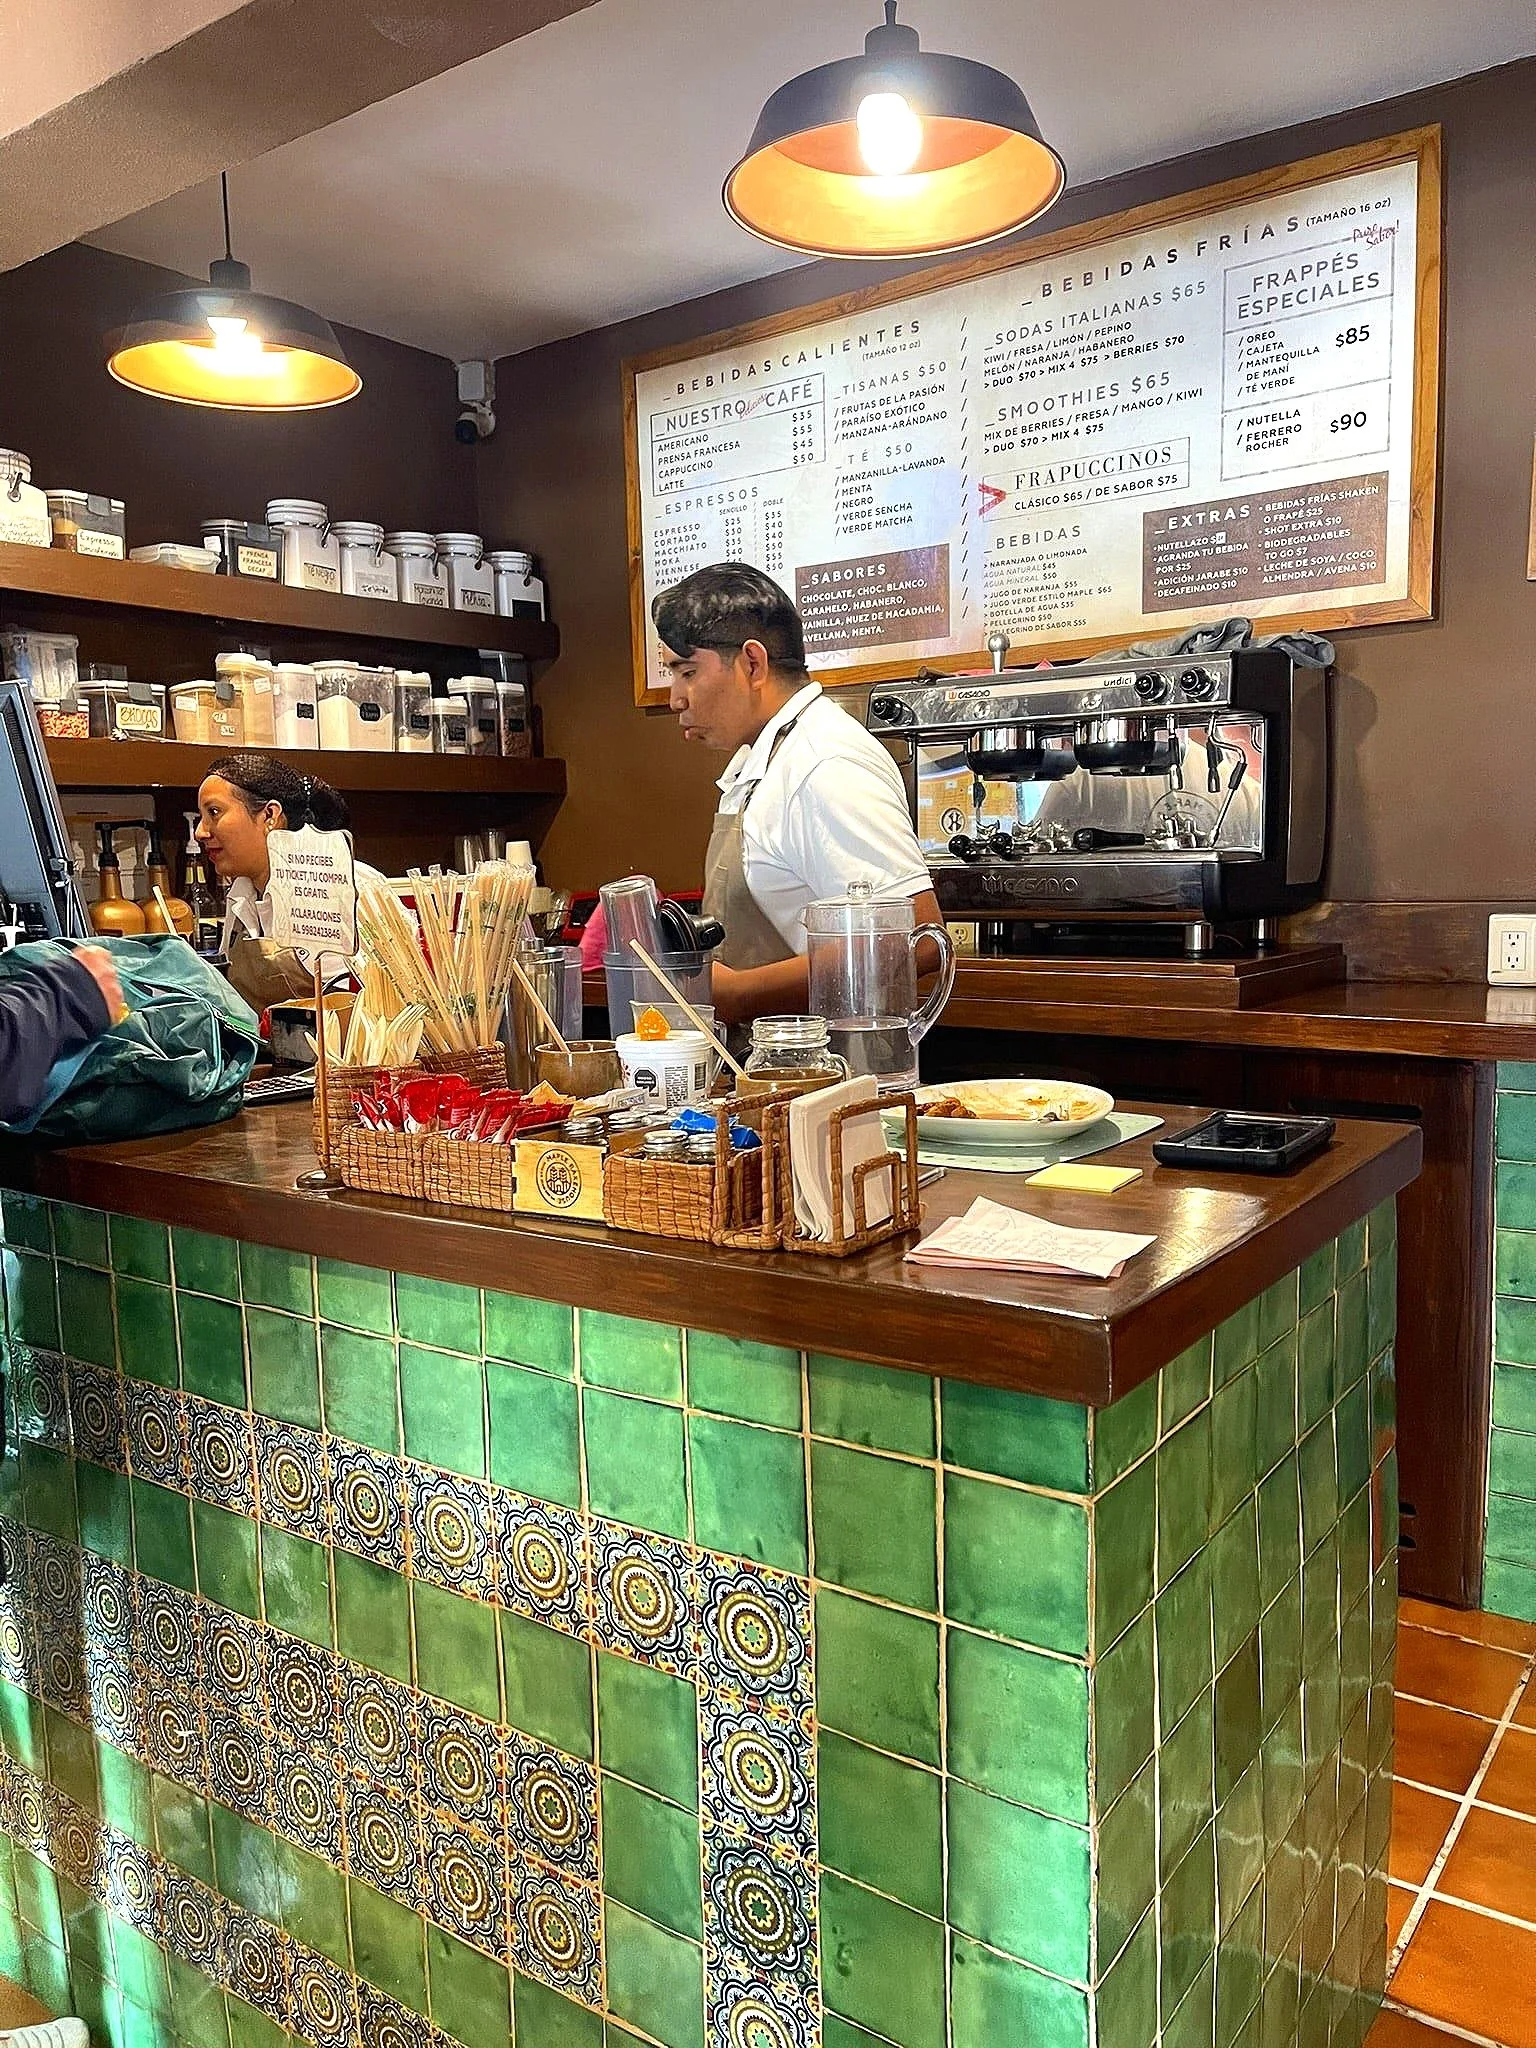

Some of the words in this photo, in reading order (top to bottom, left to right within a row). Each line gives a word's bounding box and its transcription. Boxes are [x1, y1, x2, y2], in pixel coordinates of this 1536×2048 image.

[1197, 216, 1298, 256] FRÍAS
[1360, 203, 1370, 212] 16
[1062, 292, 1161, 328] ITALIANAS
[1172, 280, 1205, 302] $65
[1238, 272, 1379, 319] ESPECIALES
[781, 320, 919, 367] CALIENTES
[984, 353, 1004, 364] KIWI
[1014, 343, 1043, 357] FRESA
[1053, 333, 1083, 347] LIMÓN
[1095, 321, 1131, 337] PEPINO
[1246, 330, 1275, 343] OREO
[1335, 324, 1369, 347] $85
[984, 363, 1015, 377] MELÓN
[1024, 350, 1070, 367] NARANJA
[1078, 334, 1134, 354] HABANERO
[1246, 346, 1319, 368] MANTEQUILLA
[1247, 341, 1284, 355] CAJETA
[918, 361, 946, 377] $50
[992, 375, 1013, 387] DUO
[1019, 370, 1036, 381] $70
[1048, 363, 1065, 374] MIX
[1080, 355, 1098, 367] $75
[1113, 340, 1158, 359] BERRIES
[1165, 335, 1184, 347] $70
[1246, 371, 1259, 381] DE
[1263, 363, 1288, 377] MANÍ
[1132, 371, 1169, 394] $65
[1245, 383, 1257, 393] TÉ
[1261, 376, 1294, 390] VERDE
[764, 378, 812, 407] CAFÉ
[841, 399, 876, 415] FRUTAS
[879, 396, 891, 406] DE
[894, 393, 906, 403] LA
[909, 384, 944, 399] PASIÓN
[842, 412, 881, 428] PARAÍSO
[884, 402, 925, 418] EXÓTICO
[984, 430, 1002, 441] MIX
[1005, 427, 1017, 437] DE
[1021, 417, 1064, 434] BERRIES
[1075, 408, 1109, 422] FRESA
[1122, 396, 1163, 412] MANGO
[1176, 388, 1202, 401] KIWI
[1247, 409, 1300, 426] NUTELLA
[1330, 411, 1366, 433] $90
[657, 433, 708, 452] AMERICANO
[792, 410, 812, 422] $35
[993, 441, 1014, 453] DUO
[1020, 436, 1038, 448] $70
[1051, 430, 1069, 441] MIX
[1073, 428, 1079, 436] 4
[1085, 423, 1103, 434] $75
[1247, 423, 1302, 442] FERRERO
[658, 451, 691, 465] PRENSA
[694, 440, 740, 457] FRANCESA
[792, 424, 812, 436] $55
[885, 442, 912, 457] $50
[1246, 437, 1288, 452] ROCHER
[658, 460, 712, 478] CAPPUCCINO
[792, 438, 812, 450] $45
[1016, 446, 1170, 489] FRAPUCCINOS
[659, 479, 684, 492] LATTE
[793, 452, 813, 464] $50
[842, 484, 872, 496] MENTA
[1014, 495, 1059, 510] CLÁSICO
[1063, 490, 1082, 502] $65
[1095, 486, 1110, 496] DE
[1113, 478, 1153, 493] SABOR
[1158, 474, 1177, 486] $75
[1265, 498, 1305, 511] BEBIDAS
[1339, 485, 1378, 500] SHAKEN
[842, 496, 873, 508] NEGRO
[842, 508, 872, 520] VERDE
[875, 502, 912, 515] SENCHA
[842, 521, 872, 533] VERDE
[875, 515, 912, 528] MATCHA
[1263, 515, 1271, 523] O
[1306, 506, 1323, 517] $25
[1263, 524, 1290, 535] SHOT
[1292, 519, 1323, 531] EXTRA
[1323, 516, 1343, 527] $10
[1157, 536, 1208, 551] NUTELLAZO
[1264, 528, 1350, 549] BIODEGRADABLES
[654, 557, 679, 566] MOKA
[990, 556, 1036, 567] NARANJADA
[1046, 548, 1087, 559] LIMONADA
[1157, 550, 1200, 563] AGRANDA
[1202, 547, 1213, 556] TU
[1215, 542, 1248, 554] BEBIDA
[1265, 551, 1277, 560] TO
[1279, 547, 1294, 558] GO
[1296, 547, 1307, 556] $7
[1156, 565, 1173, 574] POR
[1176, 562, 1191, 572] $25
[1262, 560, 1293, 572] LECHE
[1295, 558, 1308, 569] DE
[1309, 553, 1337, 565] SOYA
[1262, 569, 1315, 583] ALMENDRA
[1323, 561, 1359, 576] AVENA
[1357, 559, 1378, 572] $10
[1195, 569, 1231, 581] JARABE
[1232, 566, 1248, 576] $10
[801, 589, 855, 603] CHOCOLATE,
[857, 584, 884, 596] CHOC.
[886, 575, 927, 591] BLANCO,
[1023, 583, 1060, 593] NARANJA
[1067, 588, 1093, 597] MAPLE
[1158, 582, 1219, 597] DECAFEINADO
[1221, 579, 1237, 589] $10
[853, 595, 905, 610] HABANERO,
[845, 613, 869, 624] NUEZ
[871, 611, 883, 620] DE
[885, 601, 944, 618] MACADAMIA,
[801, 627, 850, 645] AVELLANA,
[852, 625, 884, 638] MENTA.
[295, 854, 305, 864] NO
[305, 855, 334, 867] RECIBES
[276, 868, 284, 879] TU
[319, 872, 348, 885] COMPRA
[294, 886, 302, 896] ES
